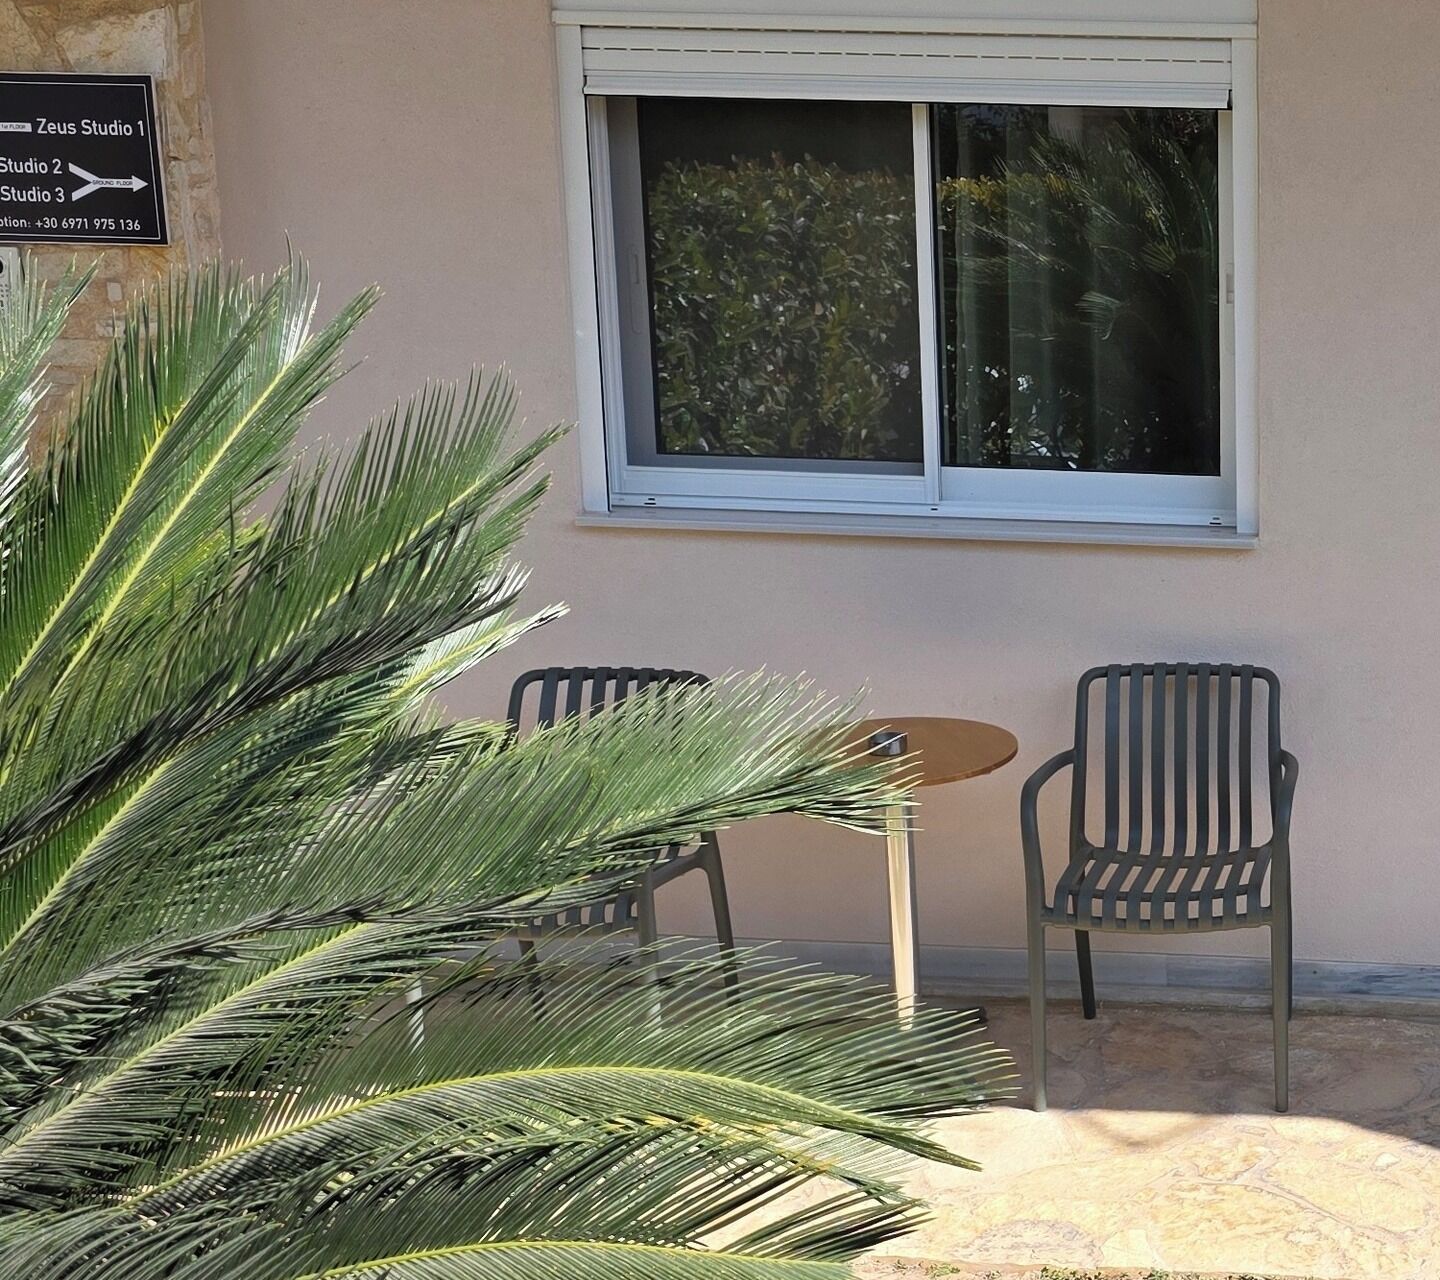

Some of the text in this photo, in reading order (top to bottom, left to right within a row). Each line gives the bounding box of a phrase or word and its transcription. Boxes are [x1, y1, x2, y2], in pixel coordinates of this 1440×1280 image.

[36, 118, 145, 137] Zeus Studio 1
[0, 157, 63, 174] Studio 2
[0, 186, 65, 203] Studio 3
[35, 217, 58, 229] +30
[62, 218, 89, 229] 6971
[94, 219, 116, 230] 975
[120, 220, 141, 231] 136
